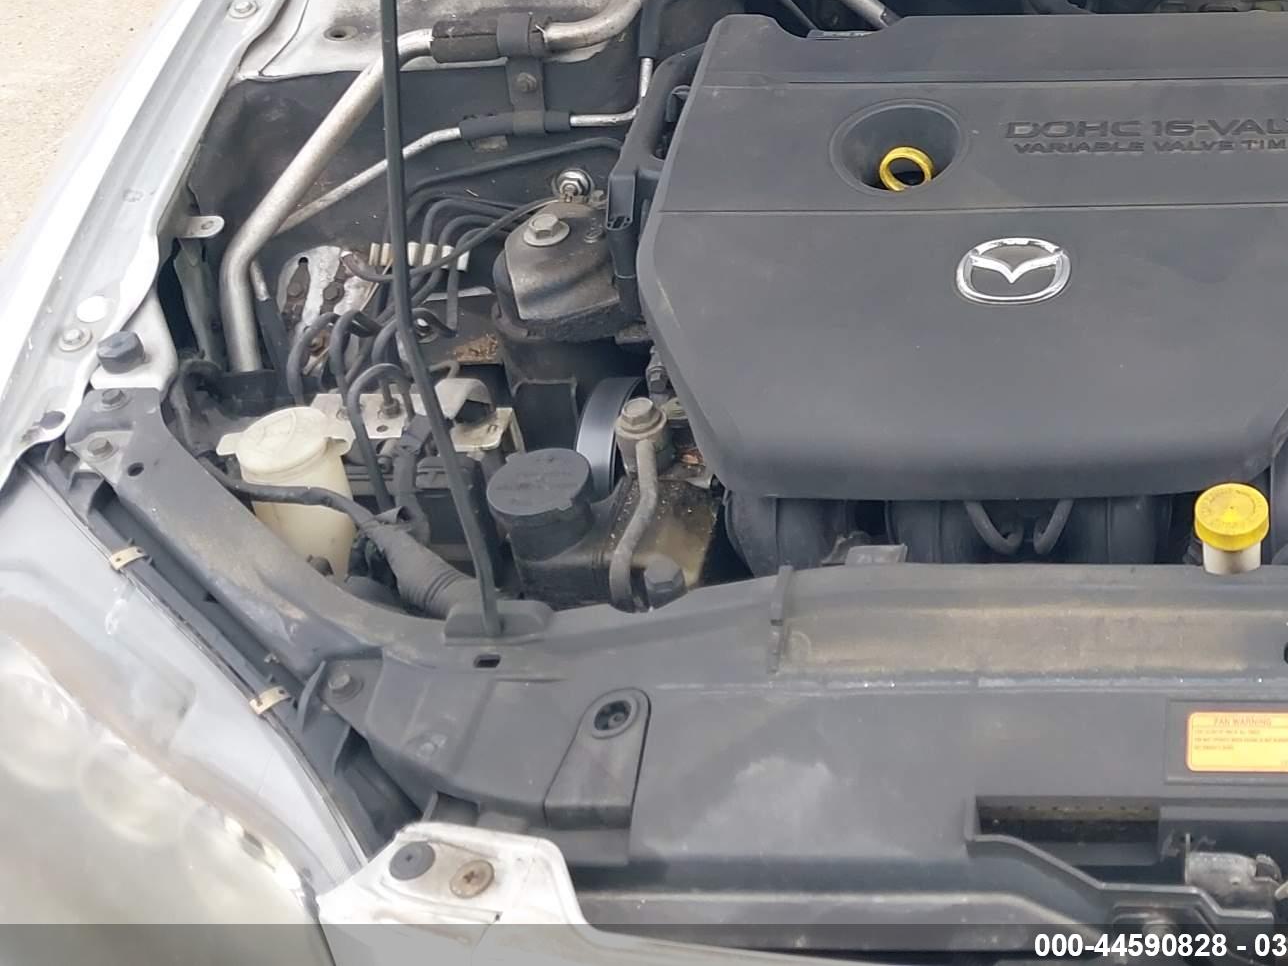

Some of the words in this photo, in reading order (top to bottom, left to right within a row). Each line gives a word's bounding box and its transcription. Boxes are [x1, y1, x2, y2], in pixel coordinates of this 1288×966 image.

[1005, 120, 1142, 139] DOHC
[1013, 140, 1145, 154] VARIABLE
[1153, 139, 1234, 153] VALVE
[1214, 717, 1231, 727] FAN
[1233, 717, 1272, 727] WARNING
